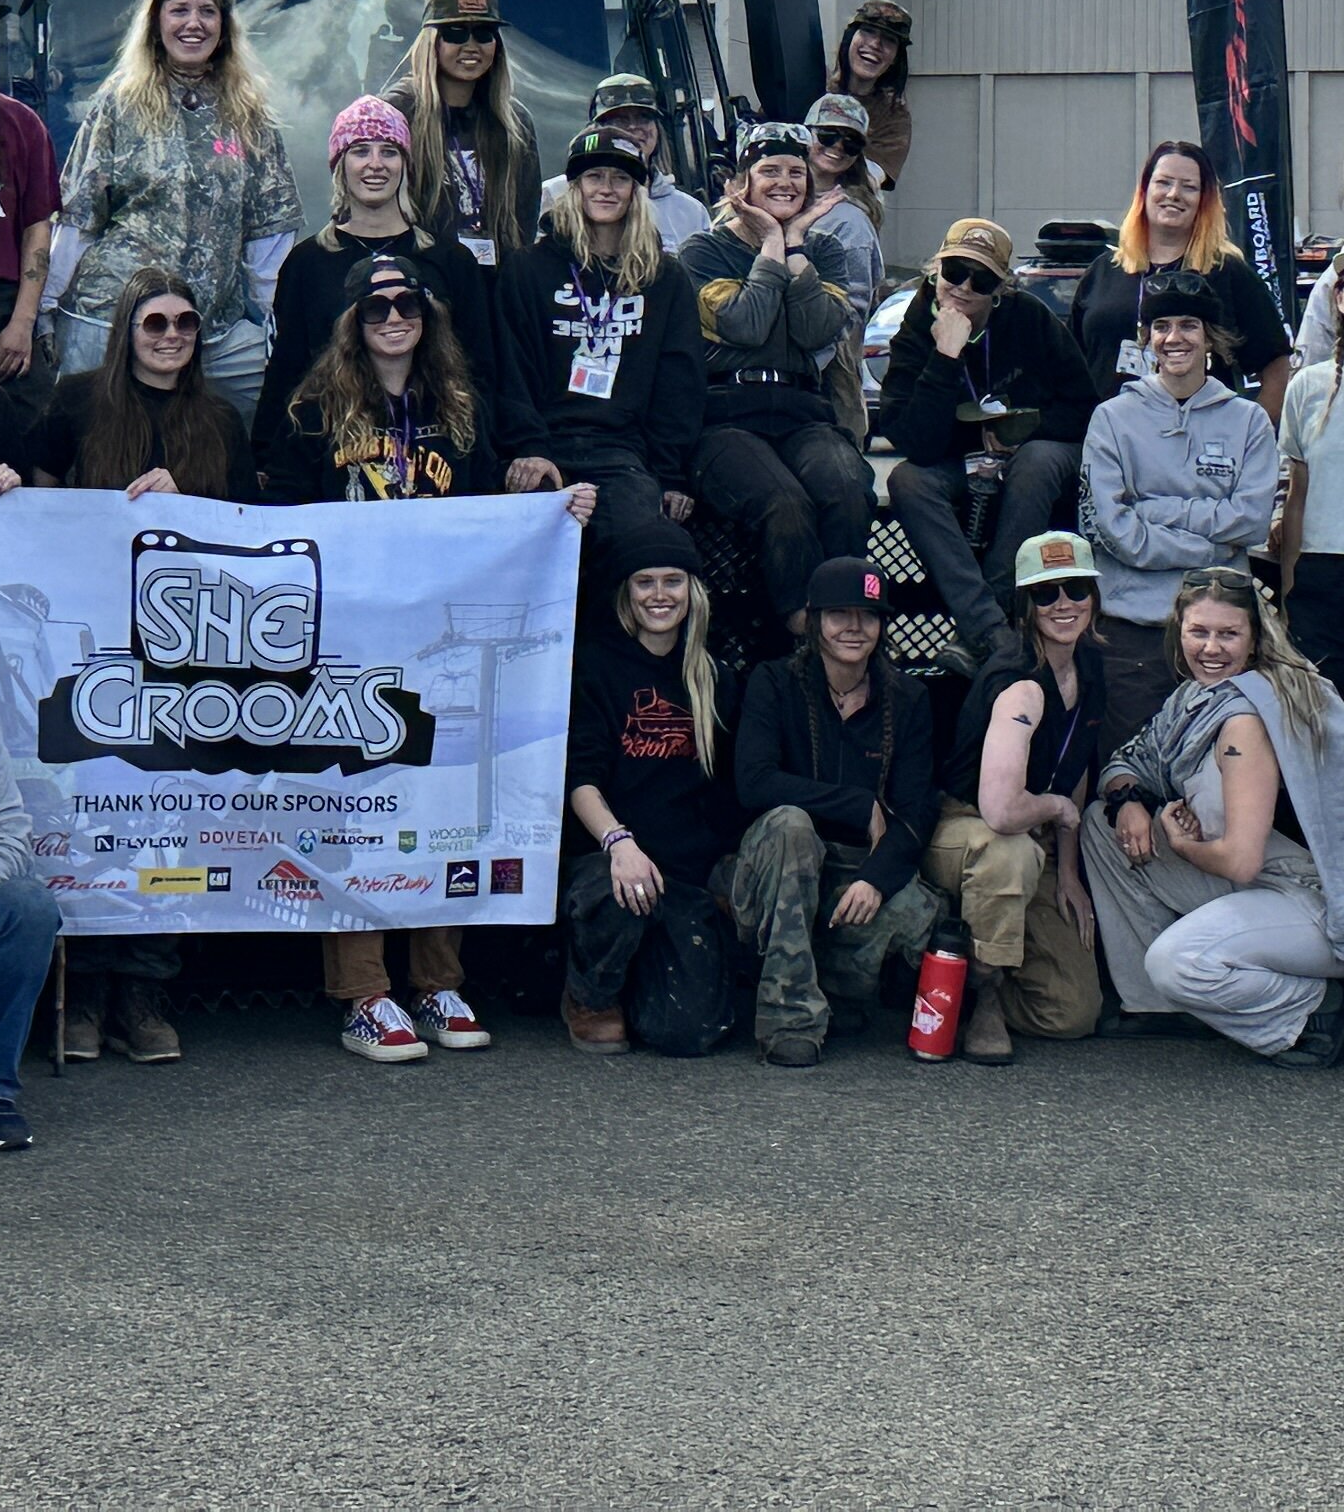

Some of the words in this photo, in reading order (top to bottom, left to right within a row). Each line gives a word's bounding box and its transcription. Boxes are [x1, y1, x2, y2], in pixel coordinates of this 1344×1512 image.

[138, 570, 315, 671] SHE
[72, 794, 144, 813] THANK
[148, 794, 193, 811] YOU
[197, 794, 226, 811] TO
[231, 793, 278, 811] OUR
[282, 794, 398, 813] SPONSORS
[116, 836, 189, 850] FLYLOW
[199, 830, 286, 845] DOVETAIL
